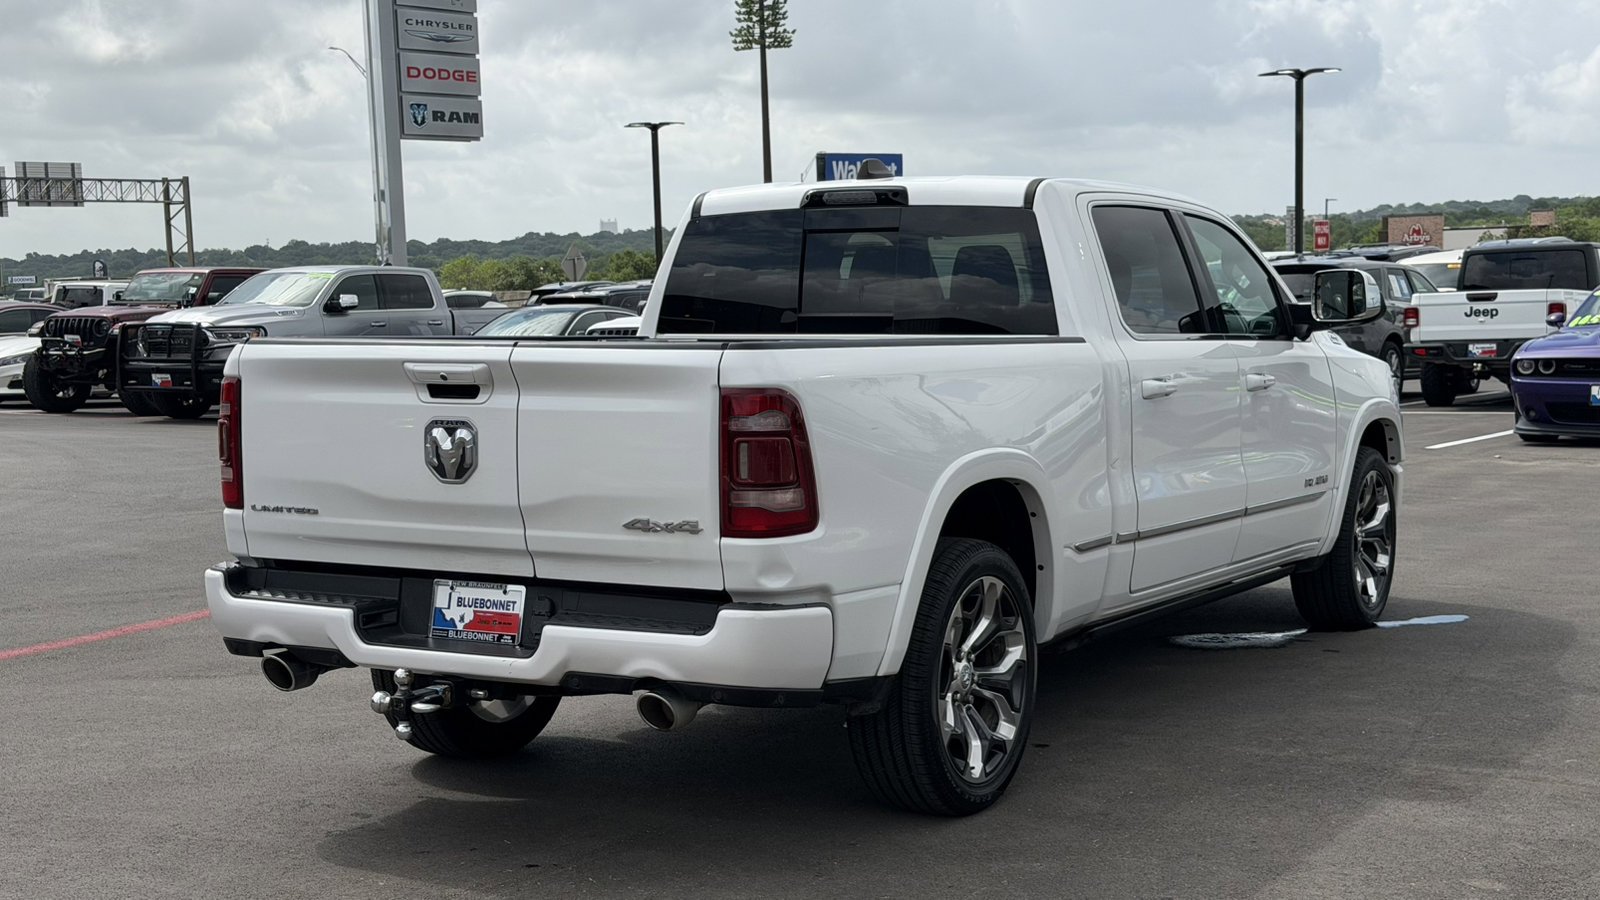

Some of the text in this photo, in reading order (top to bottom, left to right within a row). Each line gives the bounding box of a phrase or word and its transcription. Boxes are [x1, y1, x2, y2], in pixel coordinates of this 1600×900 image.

[405, 18, 473, 31] CHRYSLER
[406, 66, 477, 83] DODGE
[432, 110, 479, 124] RAM
[832, 161, 897, 180] Walt
[1402, 233, 1430, 243] Arby's
[1464, 306, 1499, 319] Jeep
[250, 504, 319, 515] LIMITED
[457, 596, 517, 612] BLUEBONNET
[448, 630, 498, 642] BLUEBONNET
